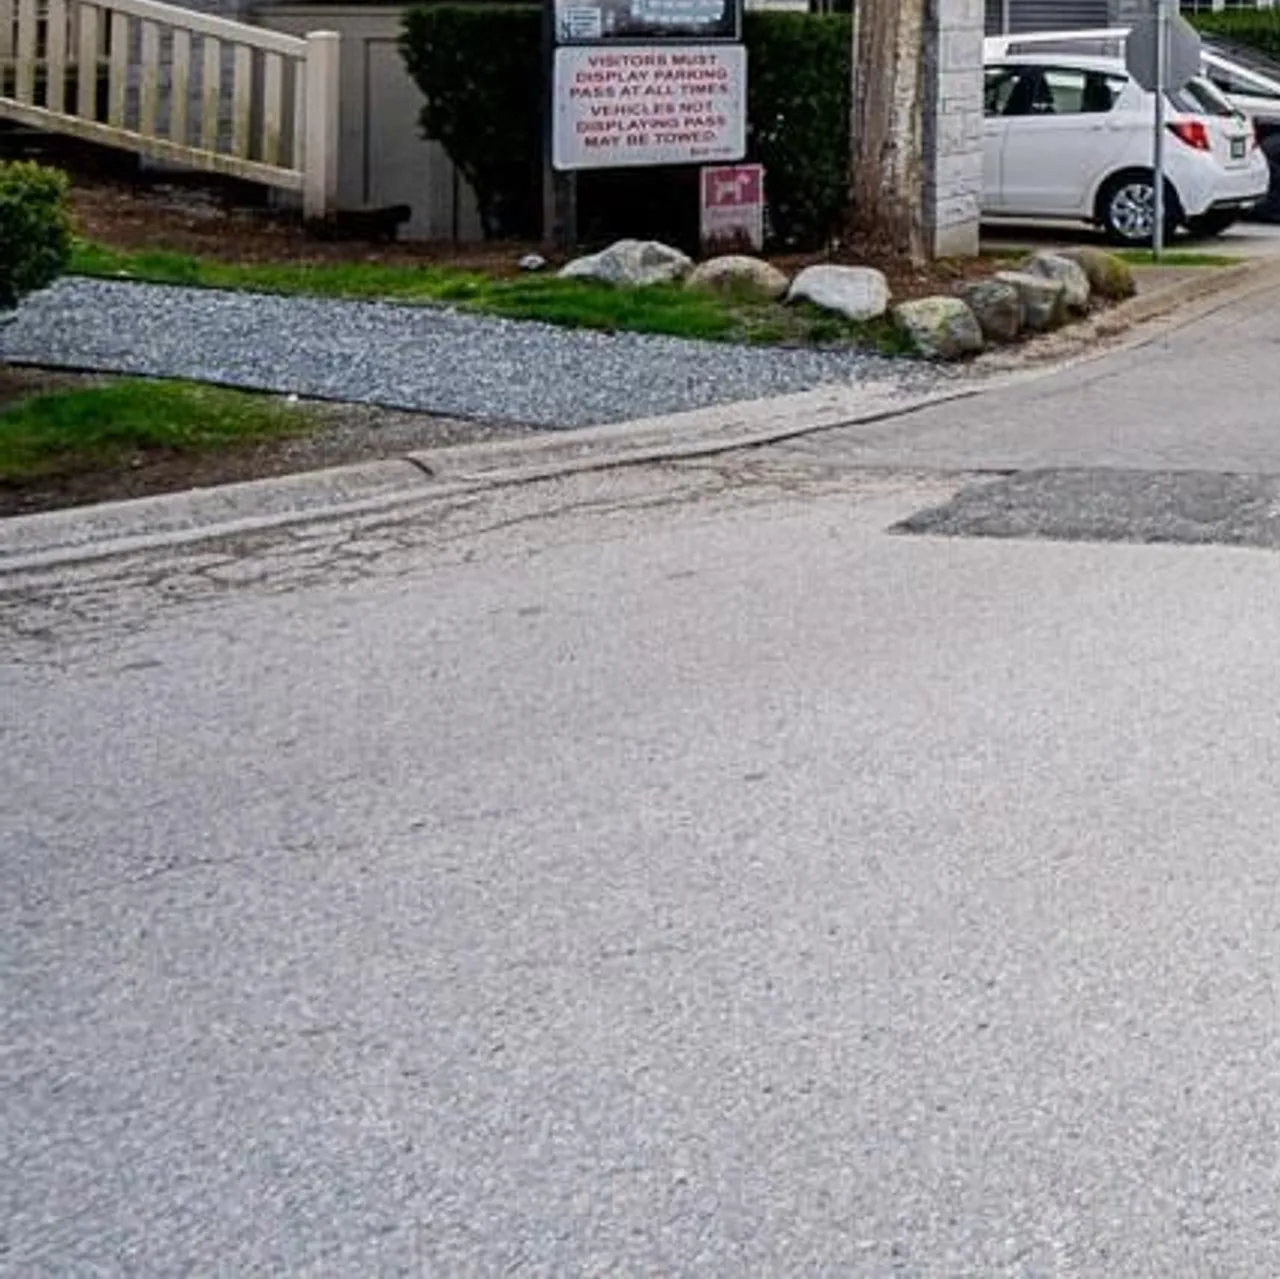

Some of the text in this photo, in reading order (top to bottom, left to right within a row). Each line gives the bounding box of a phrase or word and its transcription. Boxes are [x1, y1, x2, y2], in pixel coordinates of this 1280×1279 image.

[672, 54, 717, 66] MUST
[576, 68, 728, 83] DISPLAY PARKING
[569, 83, 729, 99] PASS AT ALL TIMES
[590, 101, 713, 117] VEHICLES NOT
[576, 118, 680, 134] DISPLAYING
[584, 134, 620, 148] MAY
[626, 133, 649, 147] BE
